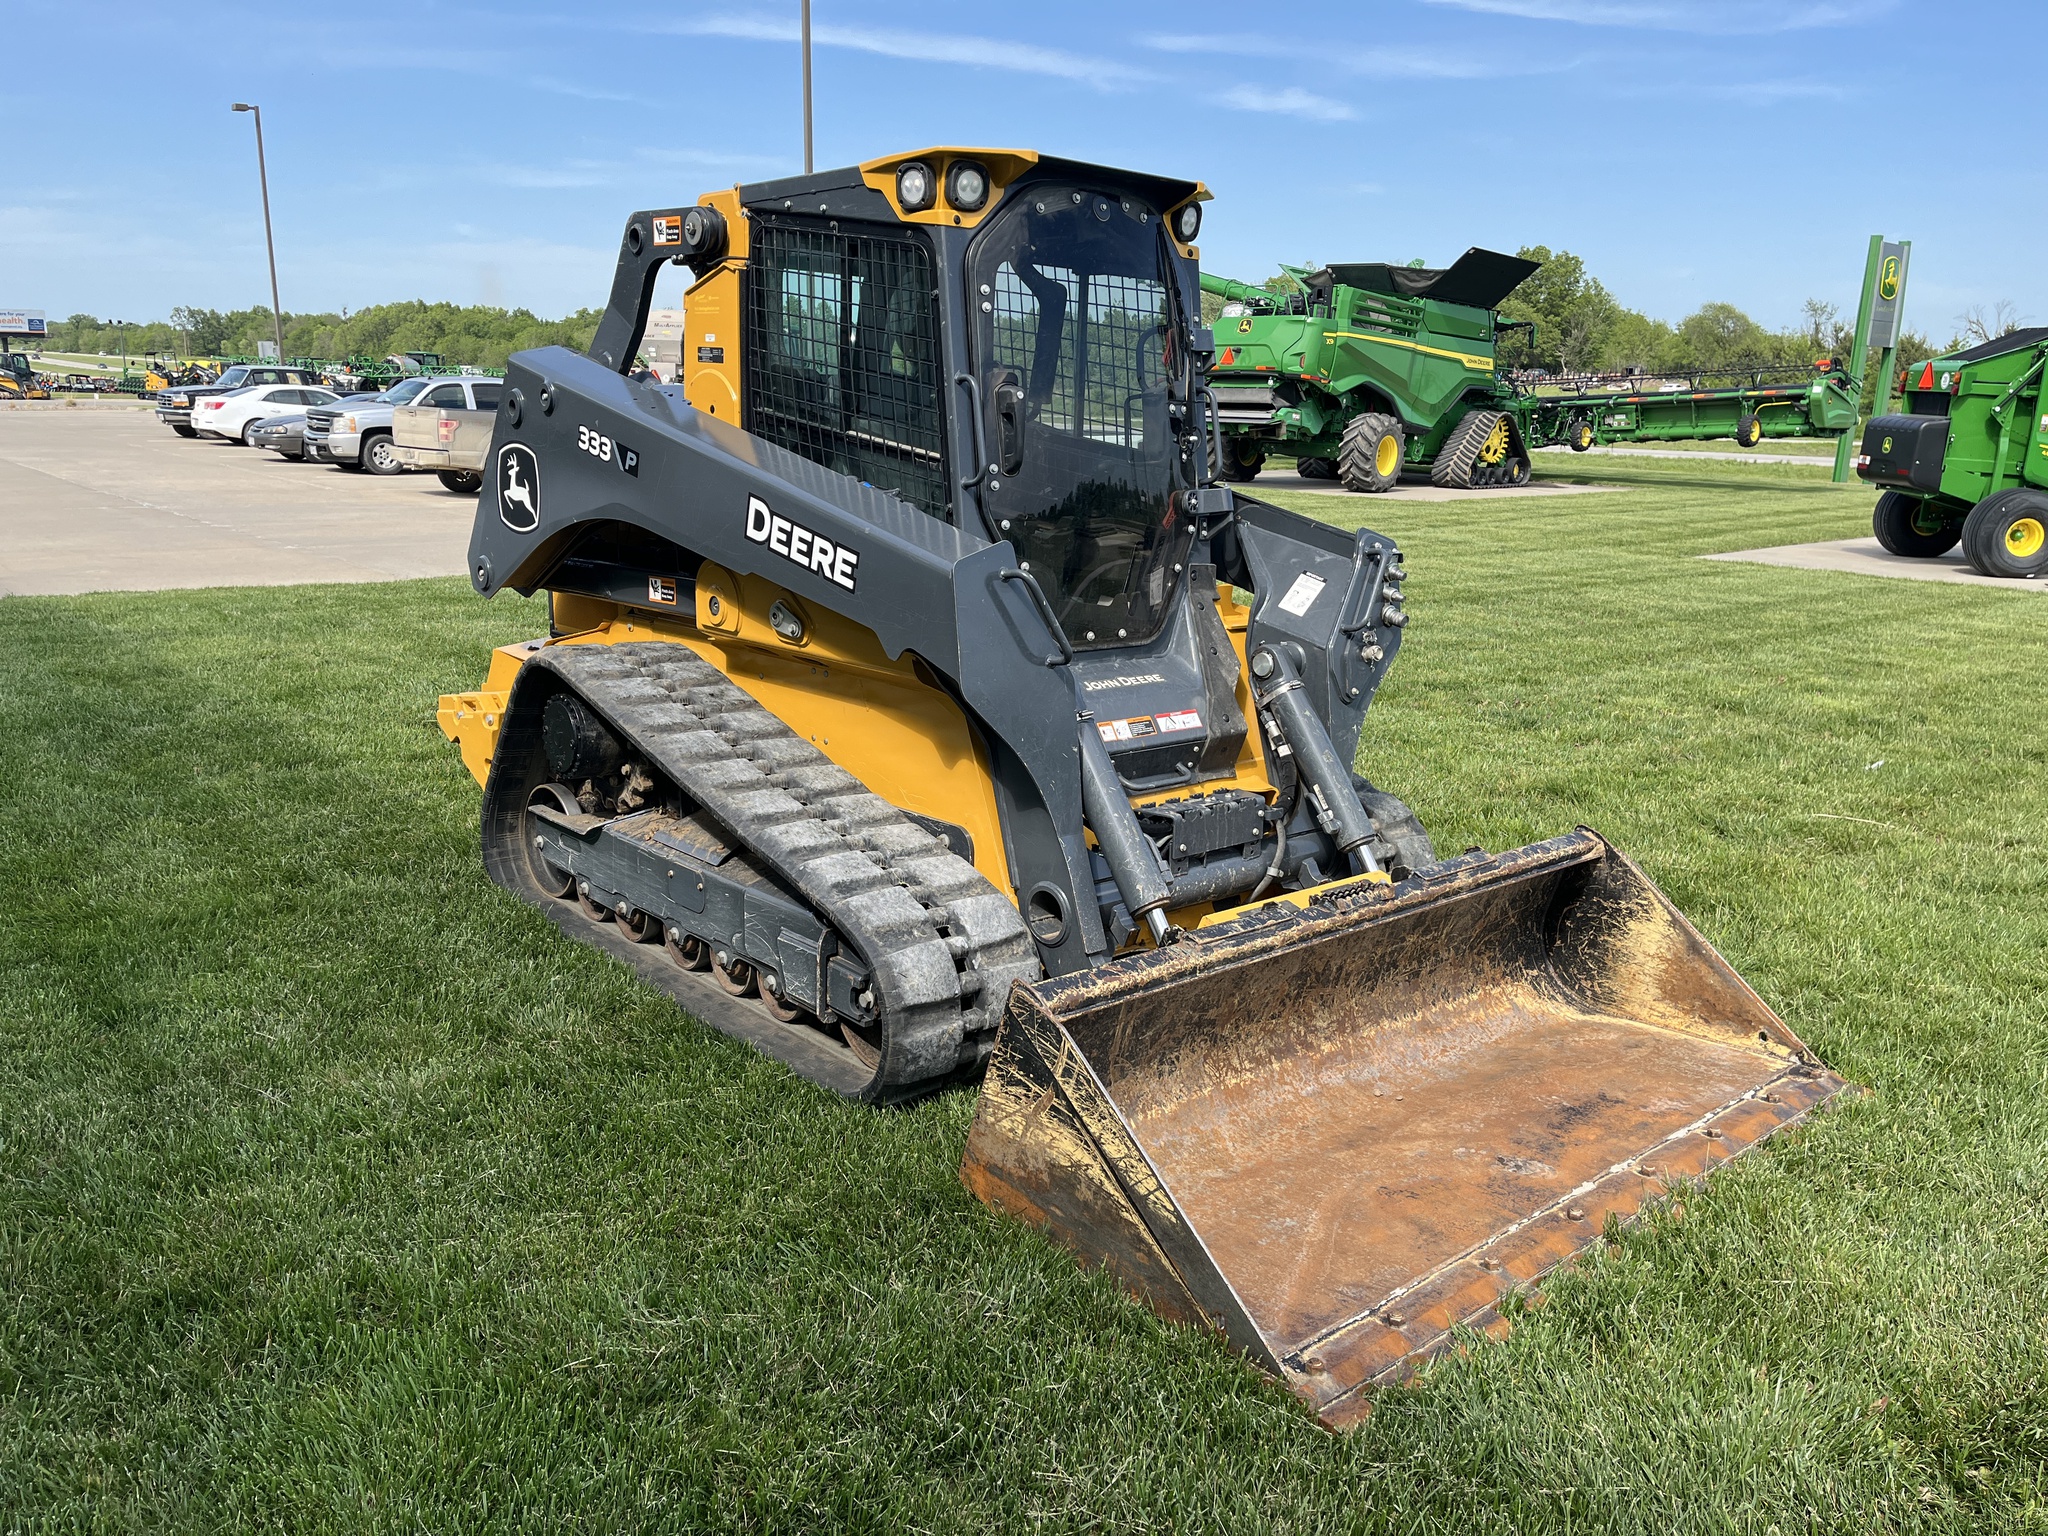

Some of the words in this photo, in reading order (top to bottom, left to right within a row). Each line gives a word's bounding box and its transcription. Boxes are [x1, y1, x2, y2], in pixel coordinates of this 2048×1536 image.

[1477, 358, 1491, 367] DEERE
[577, 424, 612, 462] 333
[625, 452, 637, 470] P
[746, 496, 858, 591] DEERE
[1083, 677, 1122, 691] JOHN
[1120, 673, 1165, 687] DEERE
